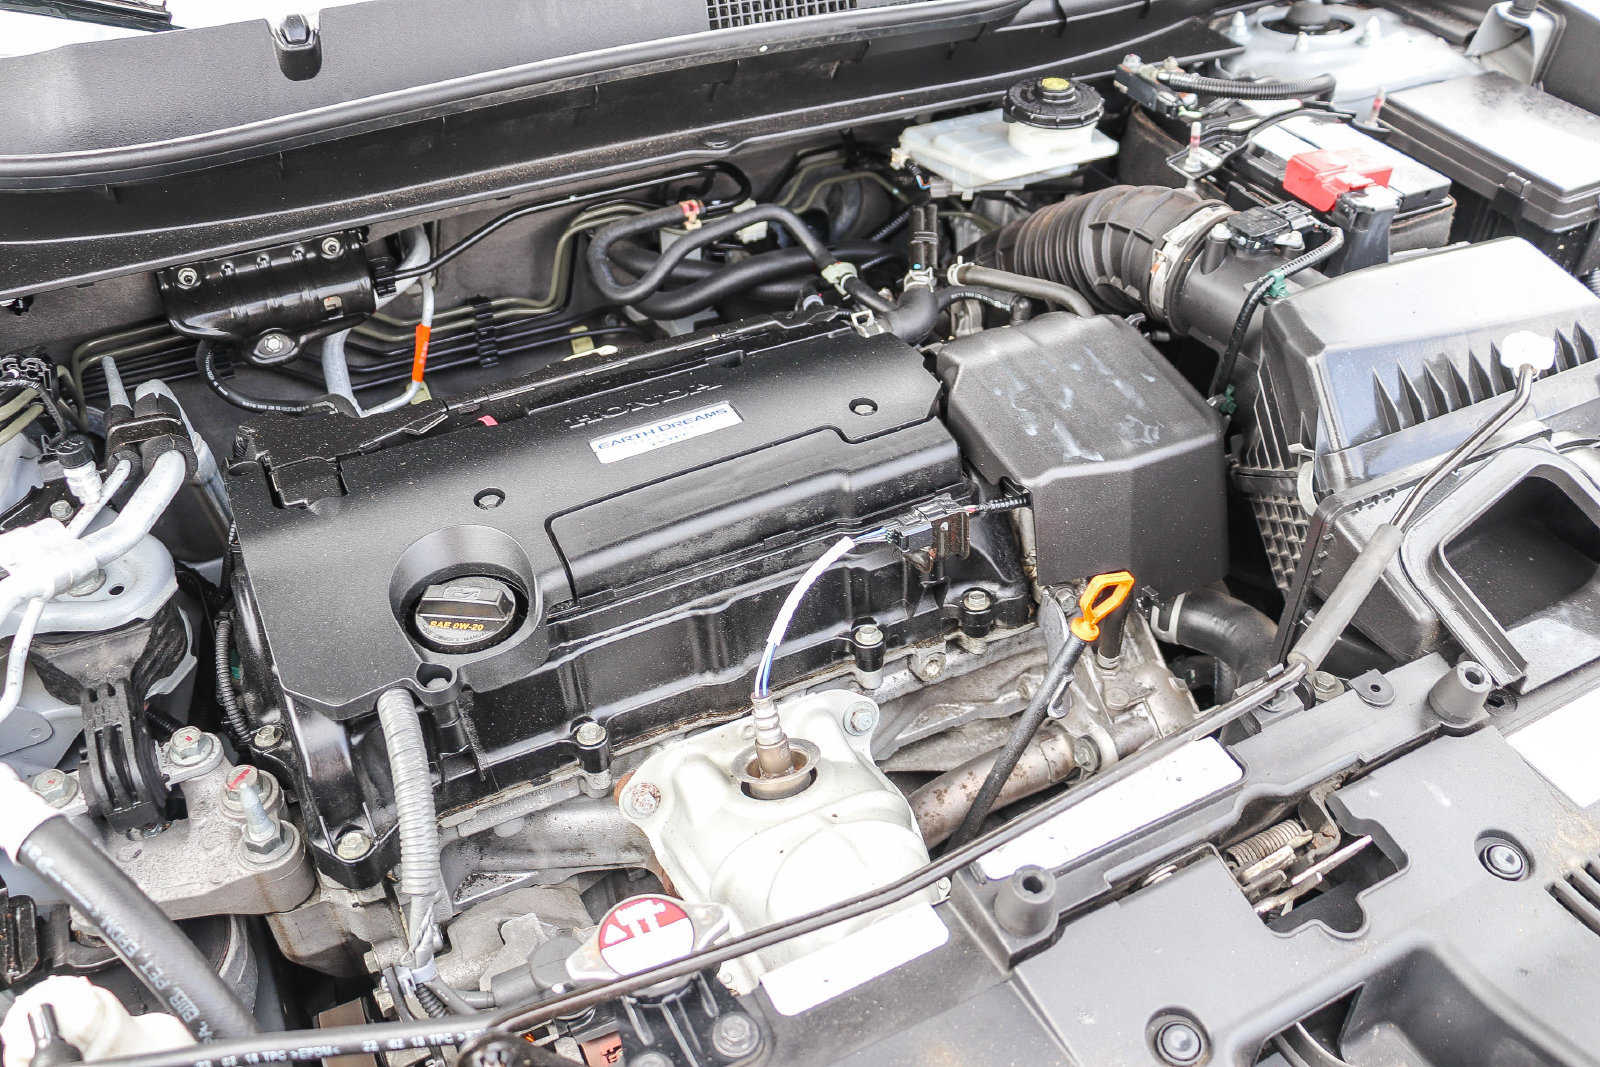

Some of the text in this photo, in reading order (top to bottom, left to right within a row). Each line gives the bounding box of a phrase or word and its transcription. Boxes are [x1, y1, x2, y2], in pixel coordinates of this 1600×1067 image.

[565, 384, 723, 429] HONDA
[598, 428, 656, 451] EARTH
[657, 408, 728, 433] DREAMS
[429, 620, 485, 631] SAE 0W-20
